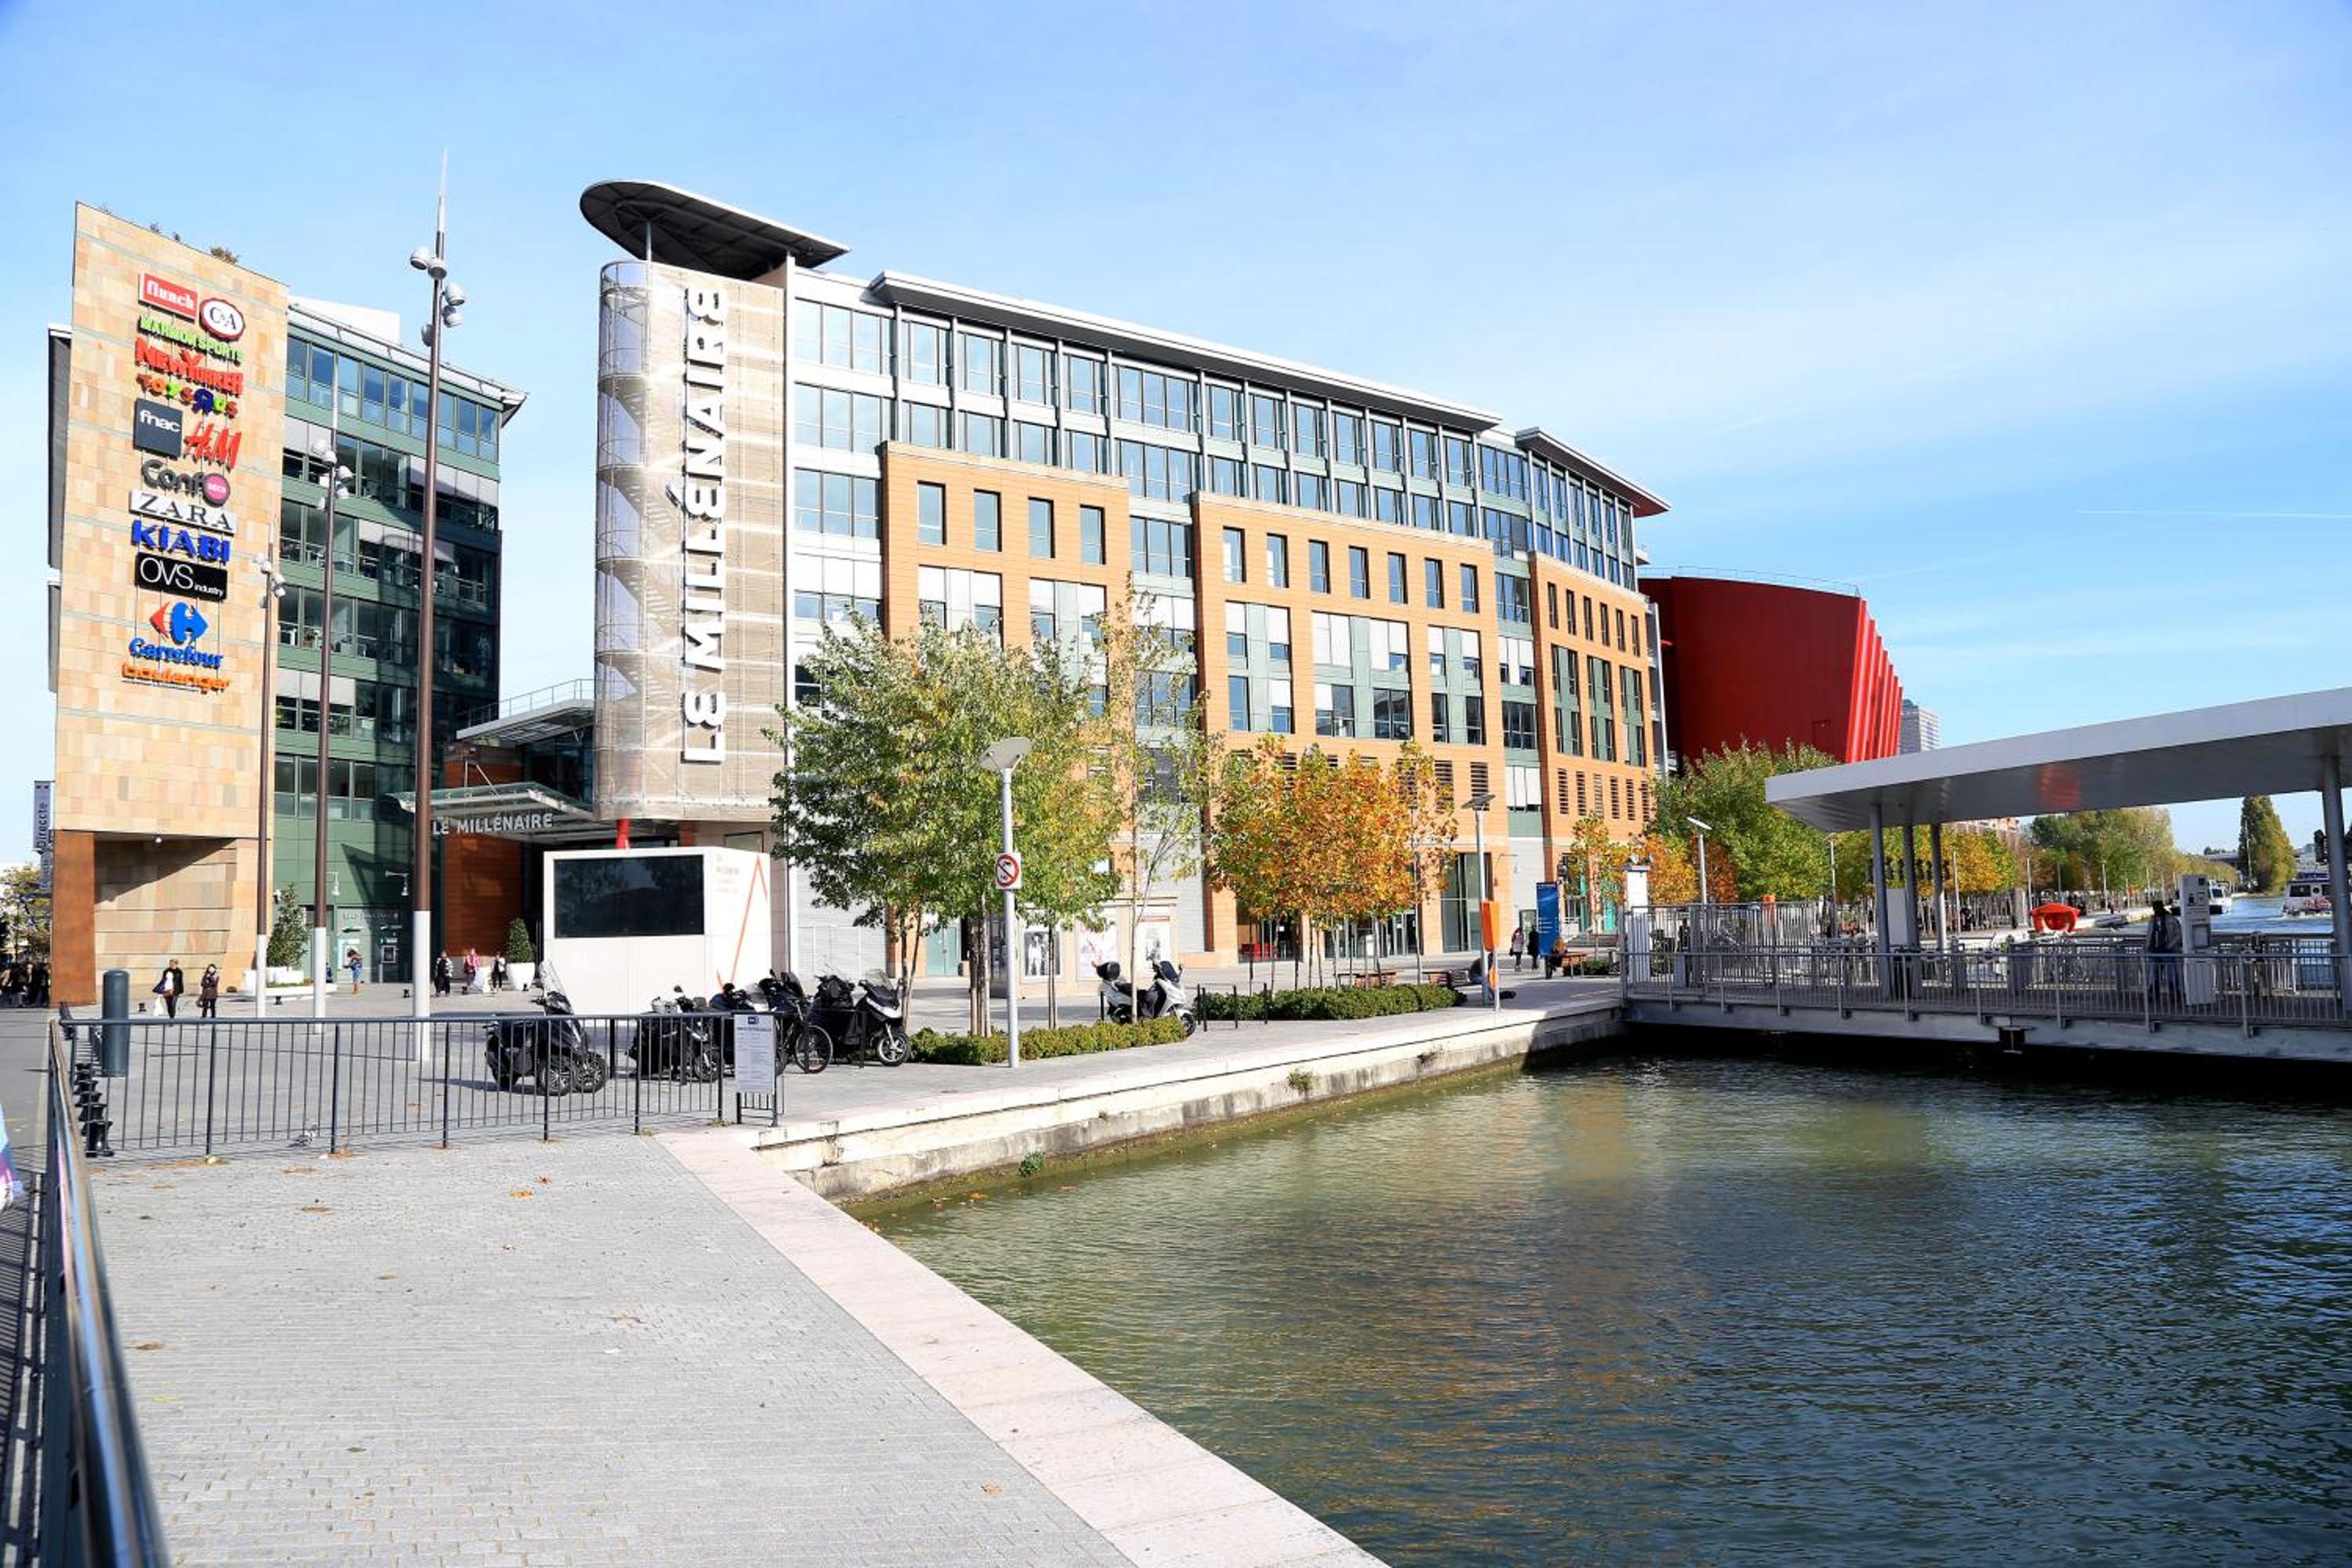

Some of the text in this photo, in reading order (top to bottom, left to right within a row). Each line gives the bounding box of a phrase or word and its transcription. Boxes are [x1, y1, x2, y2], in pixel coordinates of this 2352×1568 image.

[209, 307, 237, 331] C&A
[140, 409, 181, 432] fnac
[183, 422, 242, 470] H&M
[140, 492, 232, 531] ZARA
[664, 288, 728, 764] LE MILLÉNAIRE
[132, 519, 230, 564] KIABI
[140, 557, 224, 597] OVS industry
[129, 637, 224, 669] Carrefour
[122, 664, 230, 693] boulanger
[433, 812, 554, 835] LE MILLÉNAIRE
